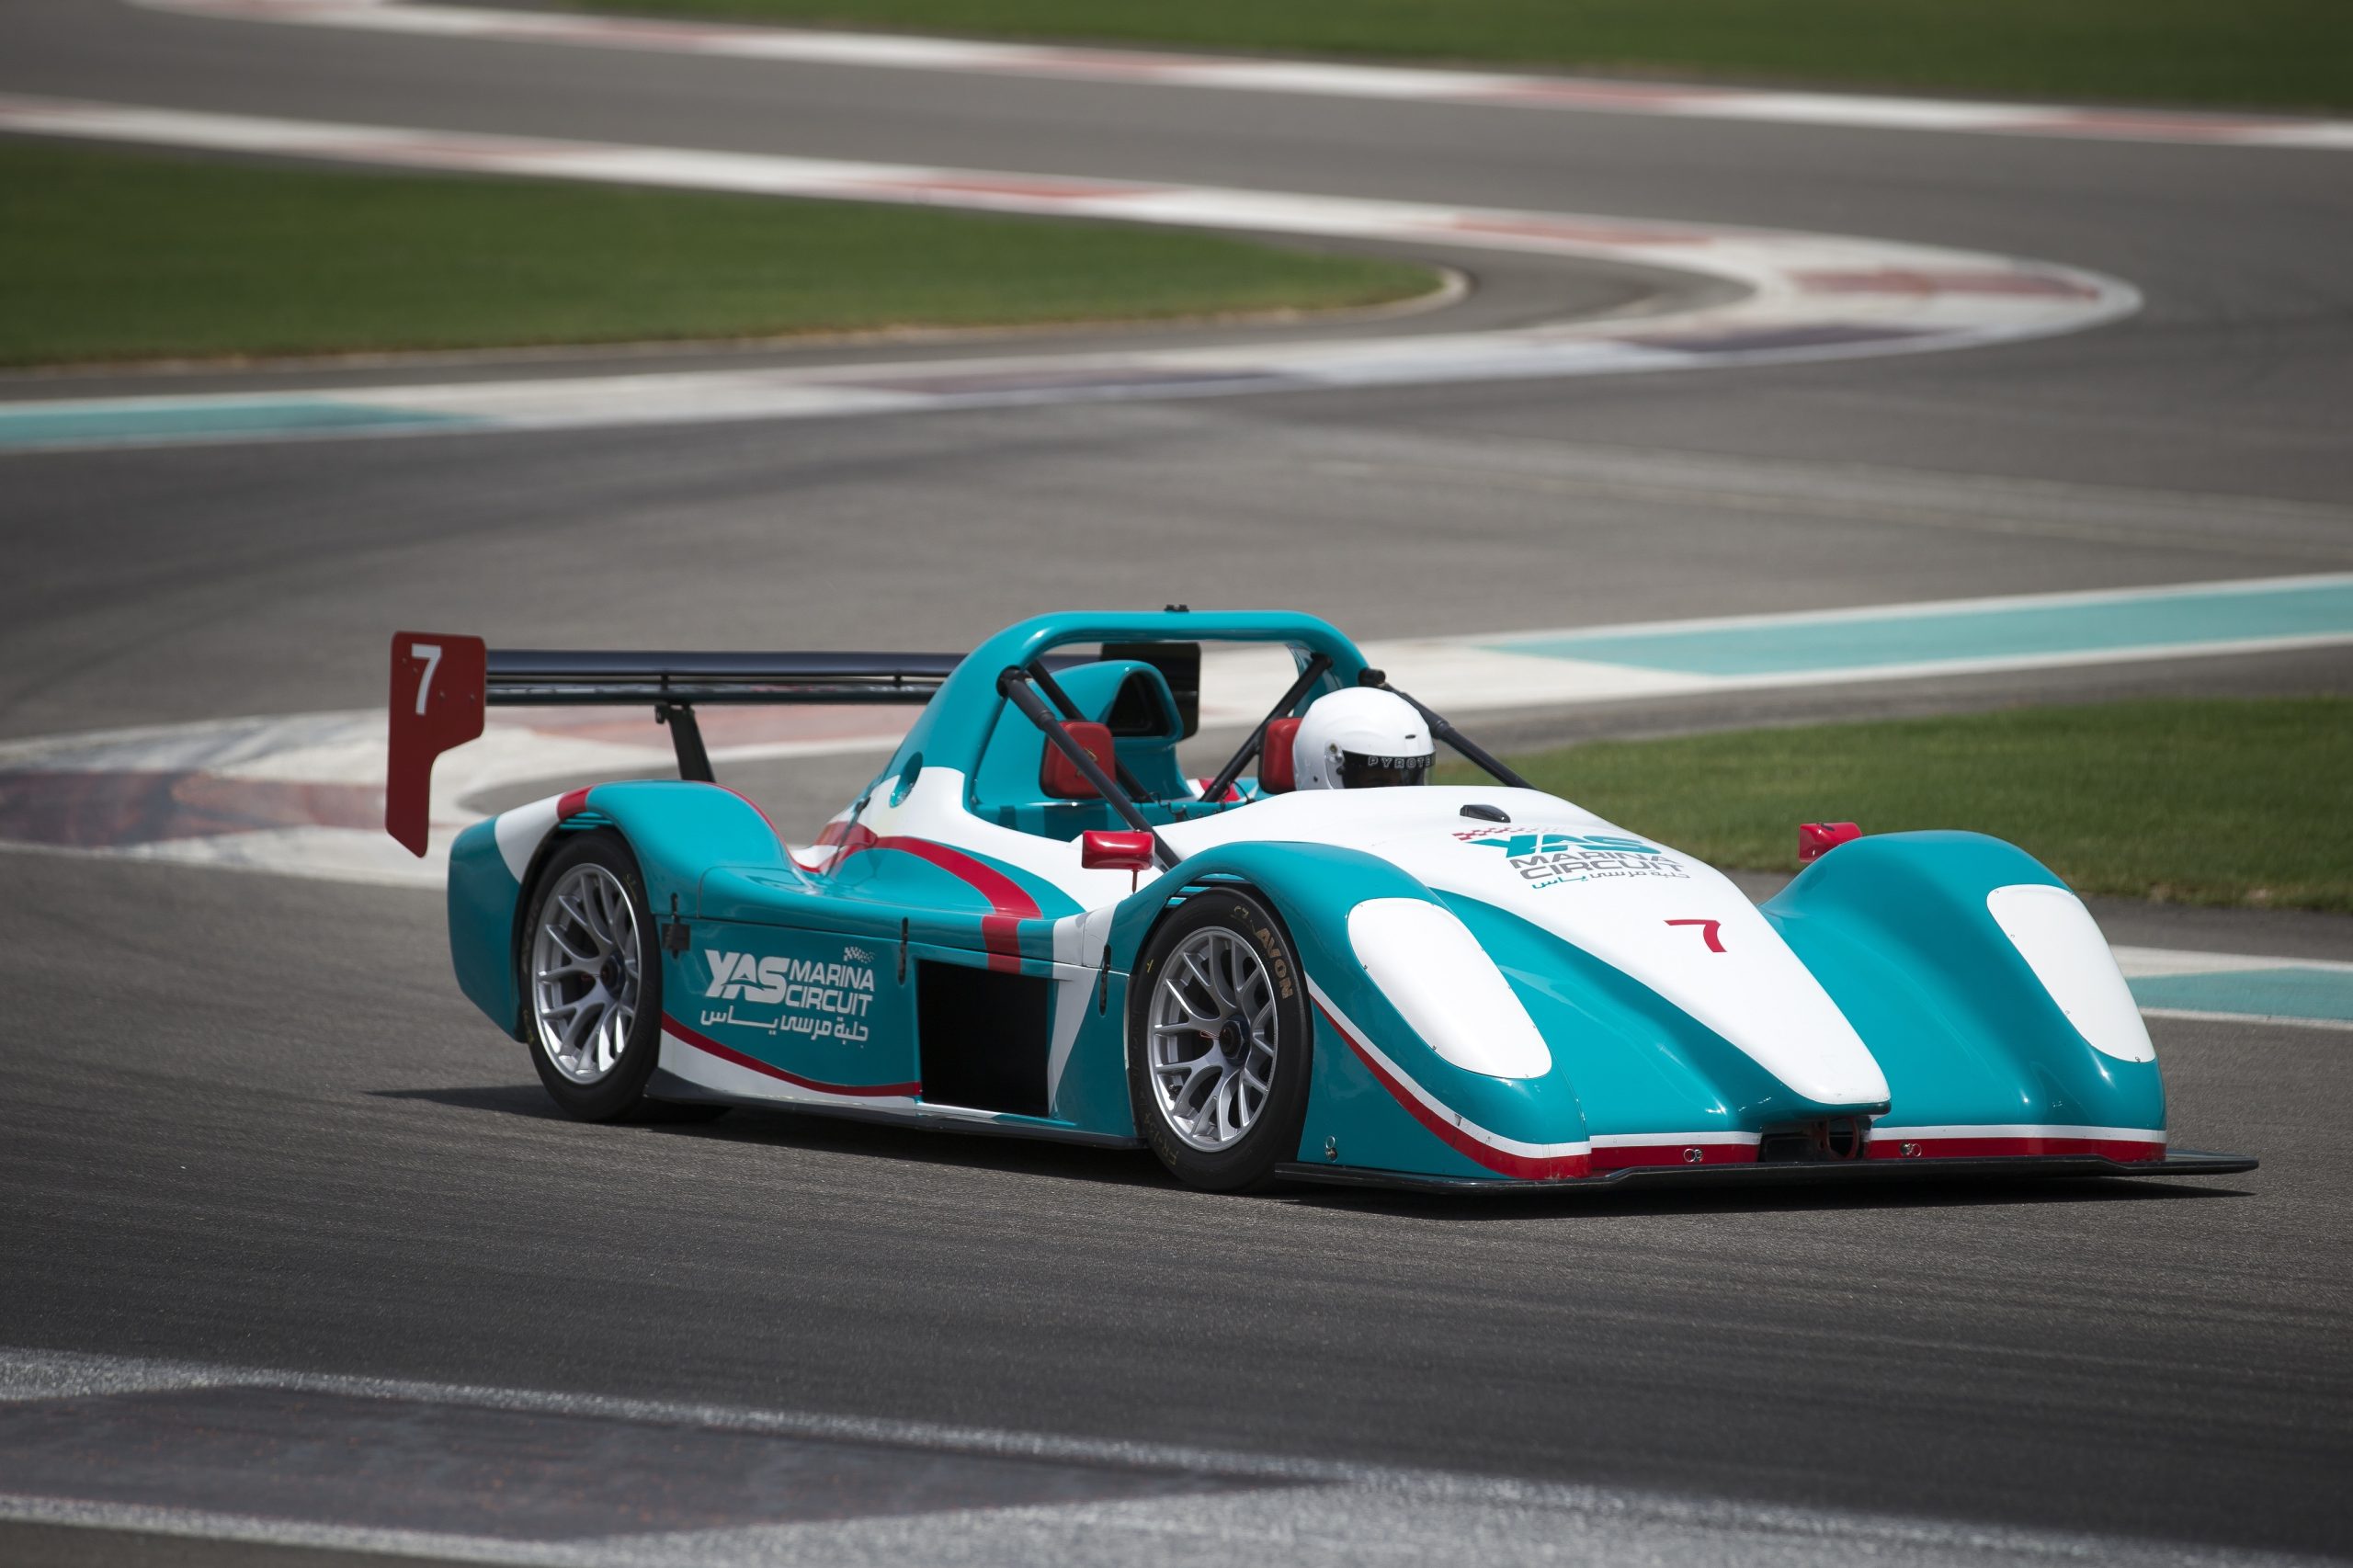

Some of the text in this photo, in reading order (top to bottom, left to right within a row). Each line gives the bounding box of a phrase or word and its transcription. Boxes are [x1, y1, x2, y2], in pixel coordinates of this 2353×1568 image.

[412, 643, 442, 716] 7
[1467, 834, 1662, 858] YAS
[1509, 851, 1679, 869] MARINA
[1520, 859, 1684, 880] CIRCUIT
[1664, 919, 1727, 952] 7
[705, 949, 790, 1004] YAS
[789, 959, 875, 992] MARINA
[1256, 927, 1294, 1000] AVON
[785, 984, 873, 1017] CIRCUIT
